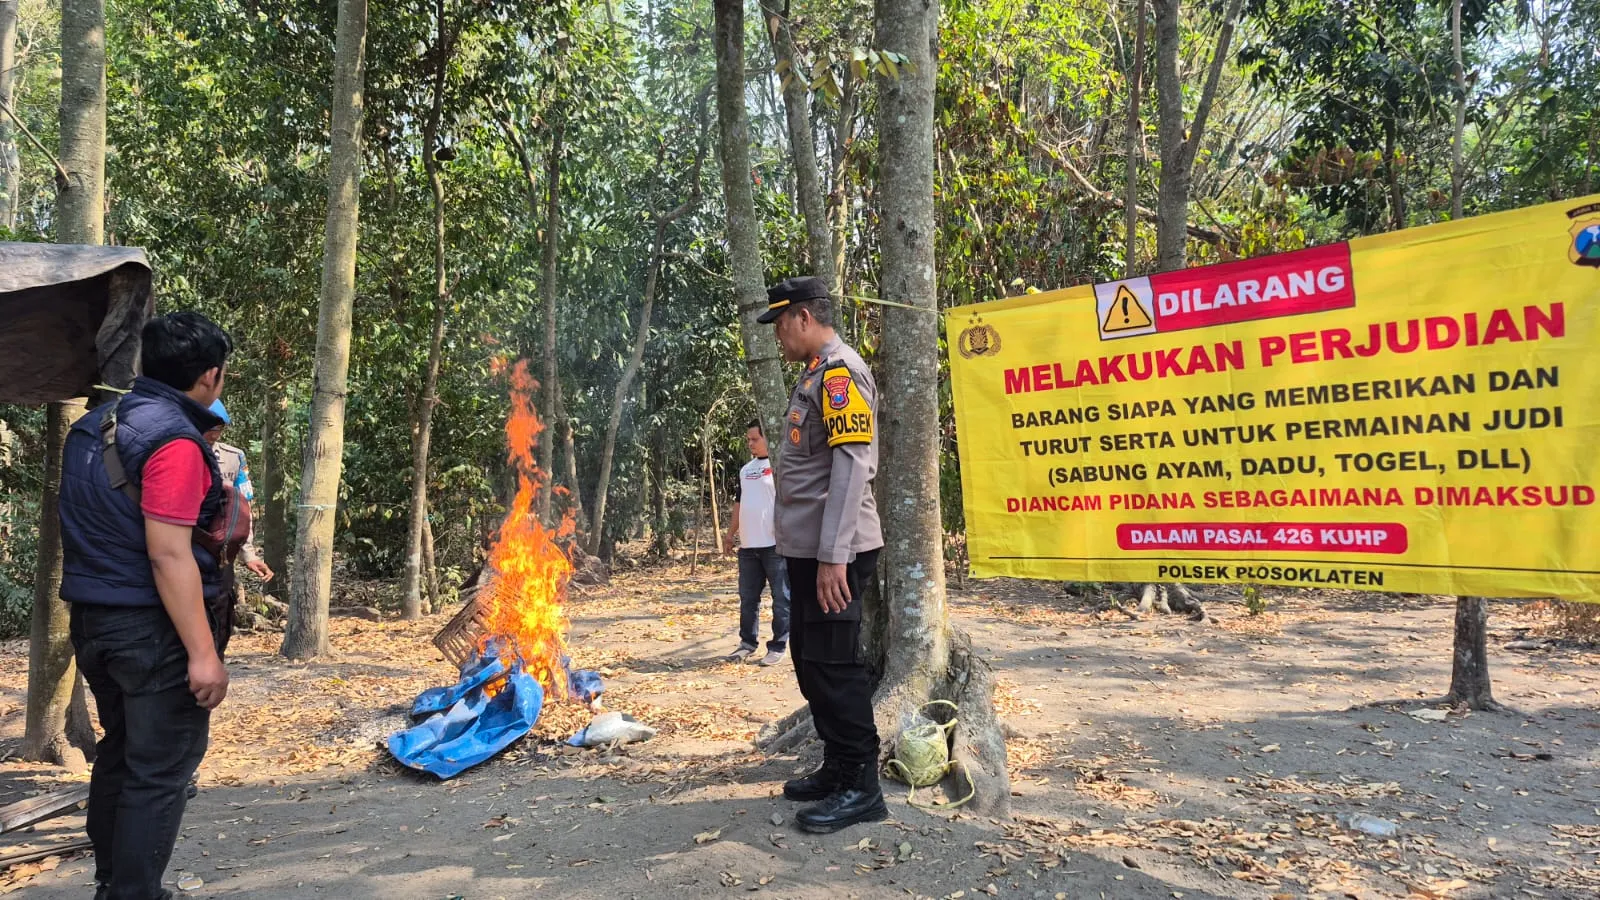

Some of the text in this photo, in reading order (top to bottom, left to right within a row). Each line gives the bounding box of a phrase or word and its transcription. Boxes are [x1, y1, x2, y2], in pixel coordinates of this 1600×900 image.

[1158, 266, 1345, 316] DILARANG
[1004, 302, 1565, 394] MELAKUKAN PERJUDIAN
[1011, 366, 1559, 429] BARANG SIAPA YANG MEMBERIKAN DAN
[1020, 406, 1563, 457] TURUT SERTA UNTUK PERMAINAN JUDI
[1048, 447, 1531, 488] (SABUNG AYAM, DADU, TOGEL, DLL)
[1007, 485, 1596, 513] DIANCAM PIDANA SEBAGAIMANA DIMAKSUD
[1130, 528, 1388, 546] DALAM PASAL 426 KUHP
[1158, 565, 1384, 586] POLSEK PLOSOKLATEN
